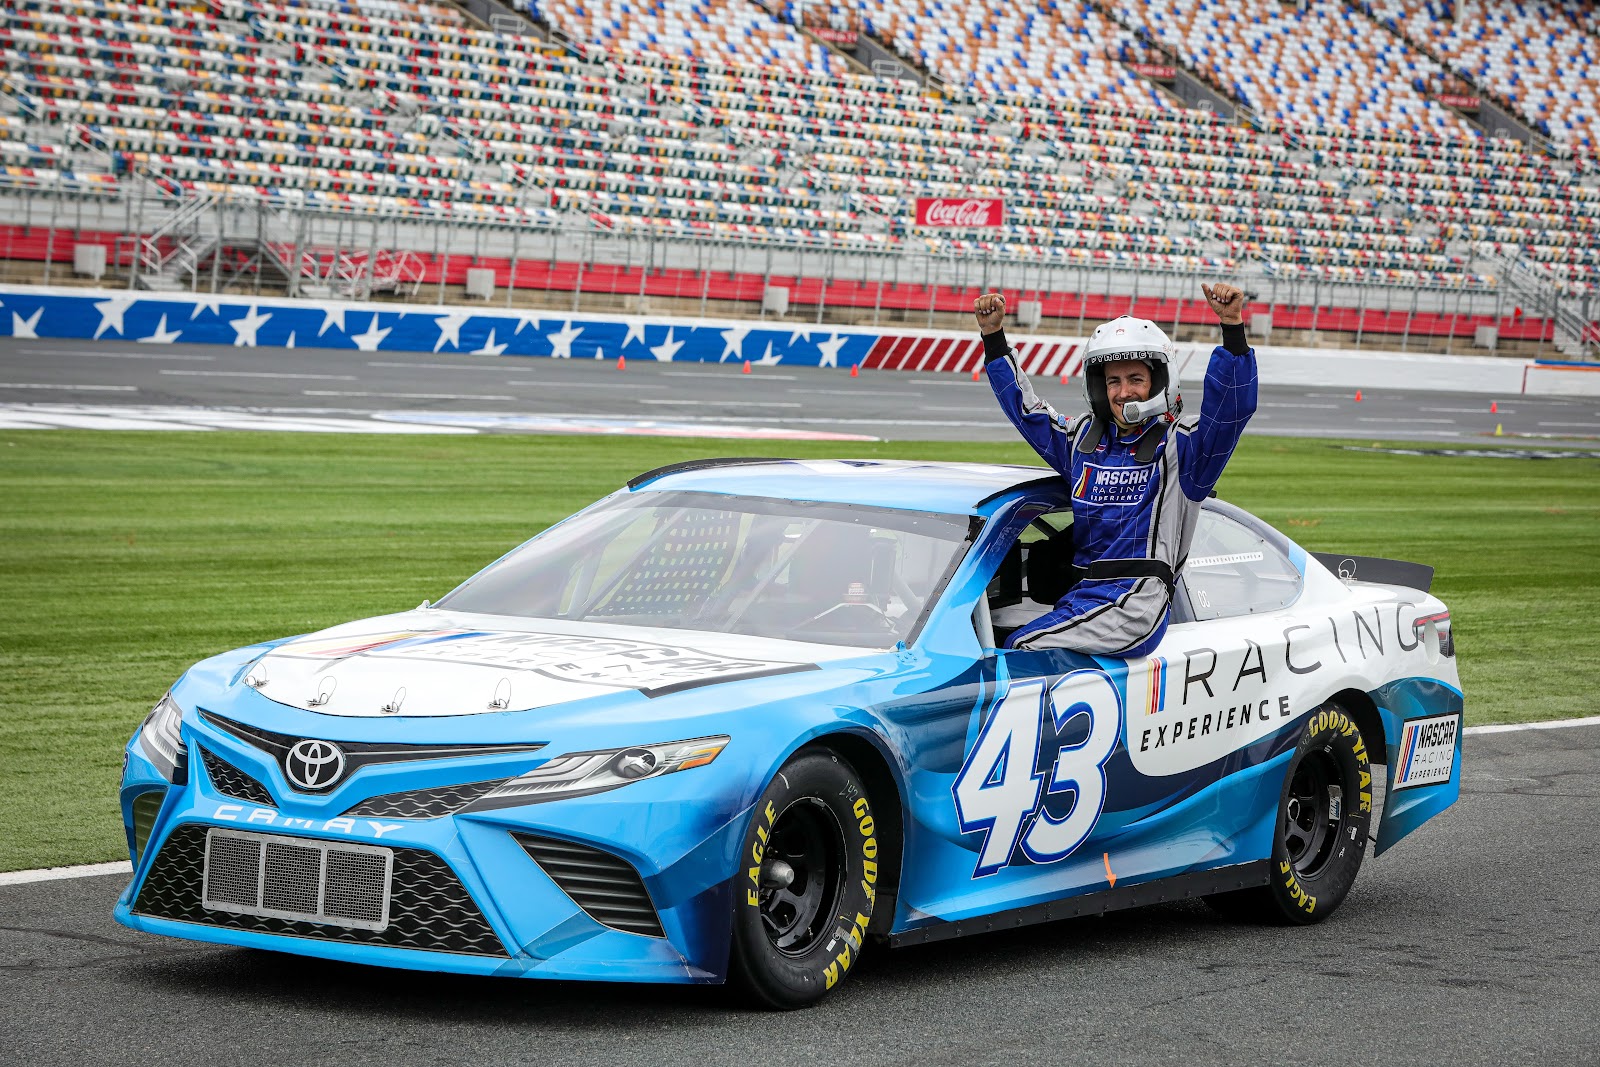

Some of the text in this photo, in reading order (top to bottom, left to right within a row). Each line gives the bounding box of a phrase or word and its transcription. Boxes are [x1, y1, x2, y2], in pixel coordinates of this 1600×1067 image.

[1092, 484, 1146, 494] RACING
[1095, 469, 1149, 485] NASCAR
[1182, 602, 1418, 705] RACING
[1140, 695, 1290, 752] EXPERIENCE
[1418, 720, 1455, 749] NASCAR
[951, 668, 1123, 880] 43
[1410, 766, 1449, 780] EXPERIENCE
[1413, 749, 1452, 765] RACING
[747, 800, 777, 907] EAGLE
[1280, 861, 1316, 914] EAGLE
